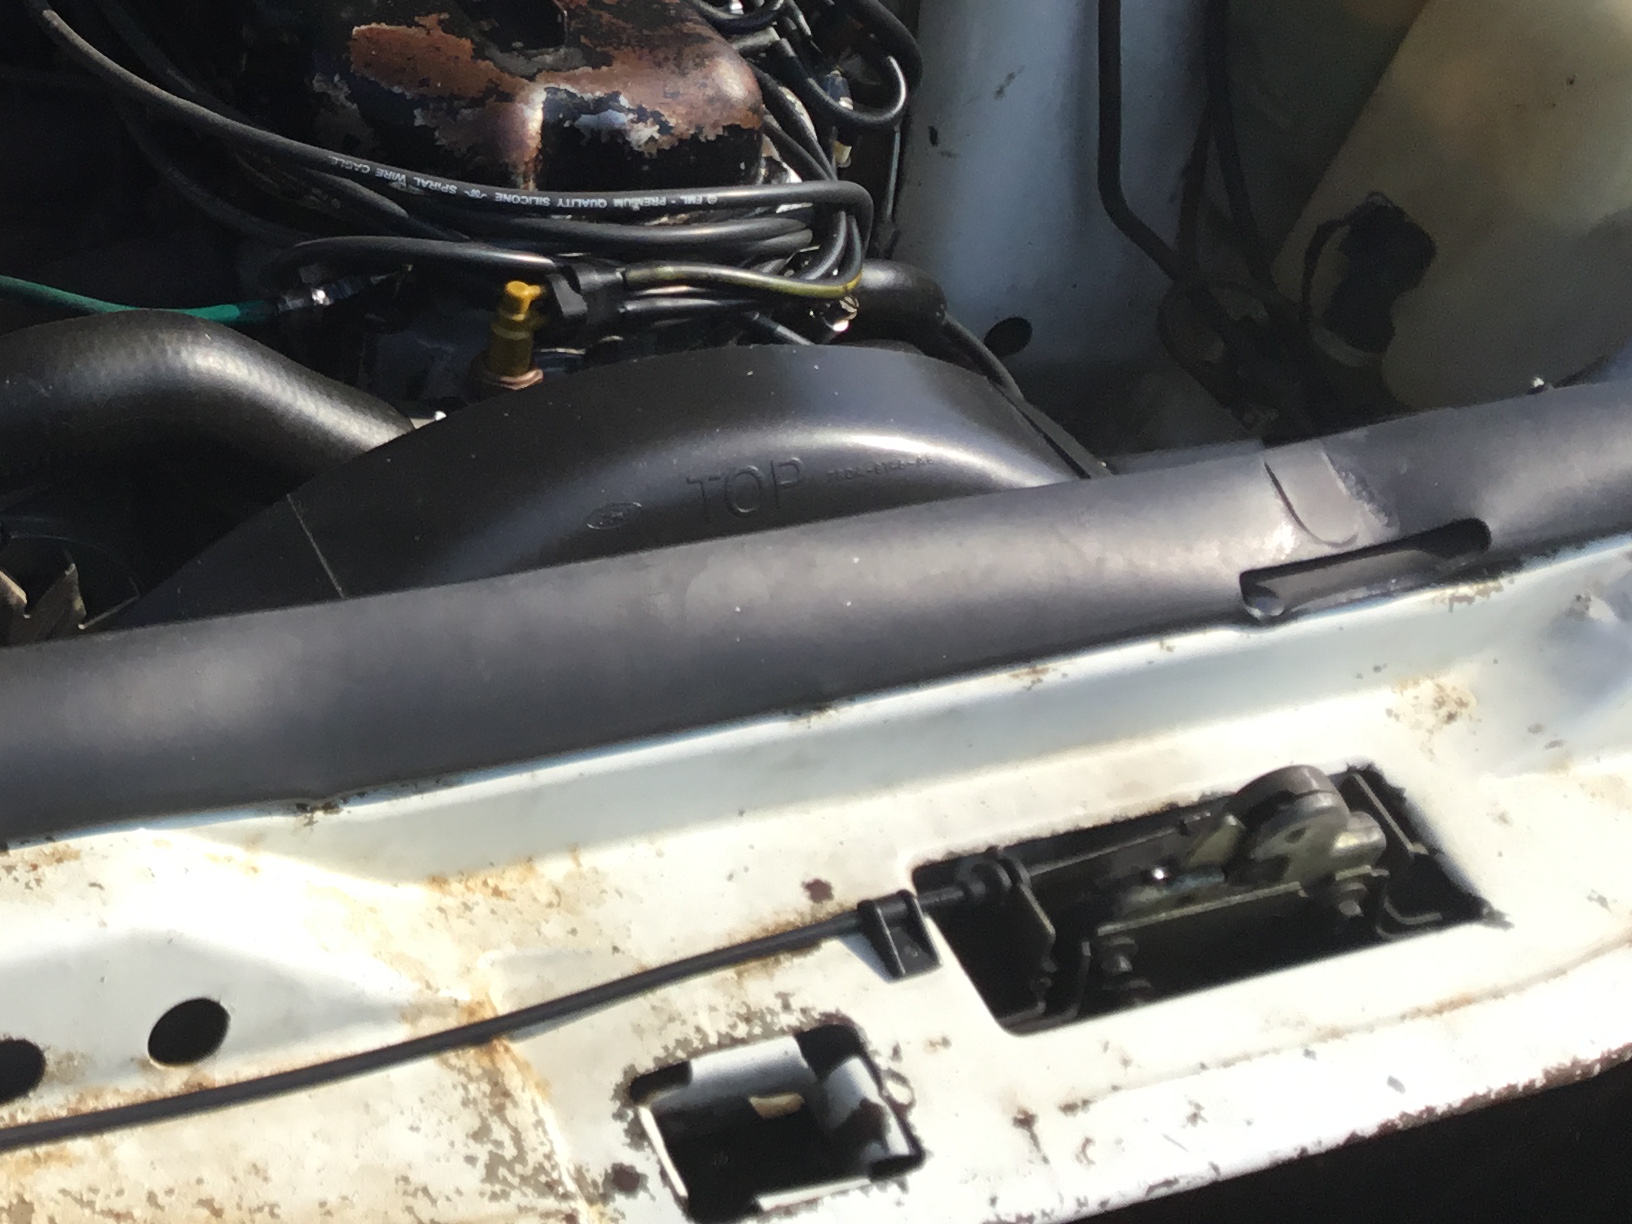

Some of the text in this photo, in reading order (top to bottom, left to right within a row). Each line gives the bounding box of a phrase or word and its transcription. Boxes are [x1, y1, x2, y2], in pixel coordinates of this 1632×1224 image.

[374, 167, 407, 185] WIRE
[413, 176, 458, 194] SPIRAL
[494, 192, 551, 207] SILICONE
[556, 197, 608, 209] QUALITY
[613, 195, 667, 207] PREMIUM
[686, 457, 805, 520] TOP
